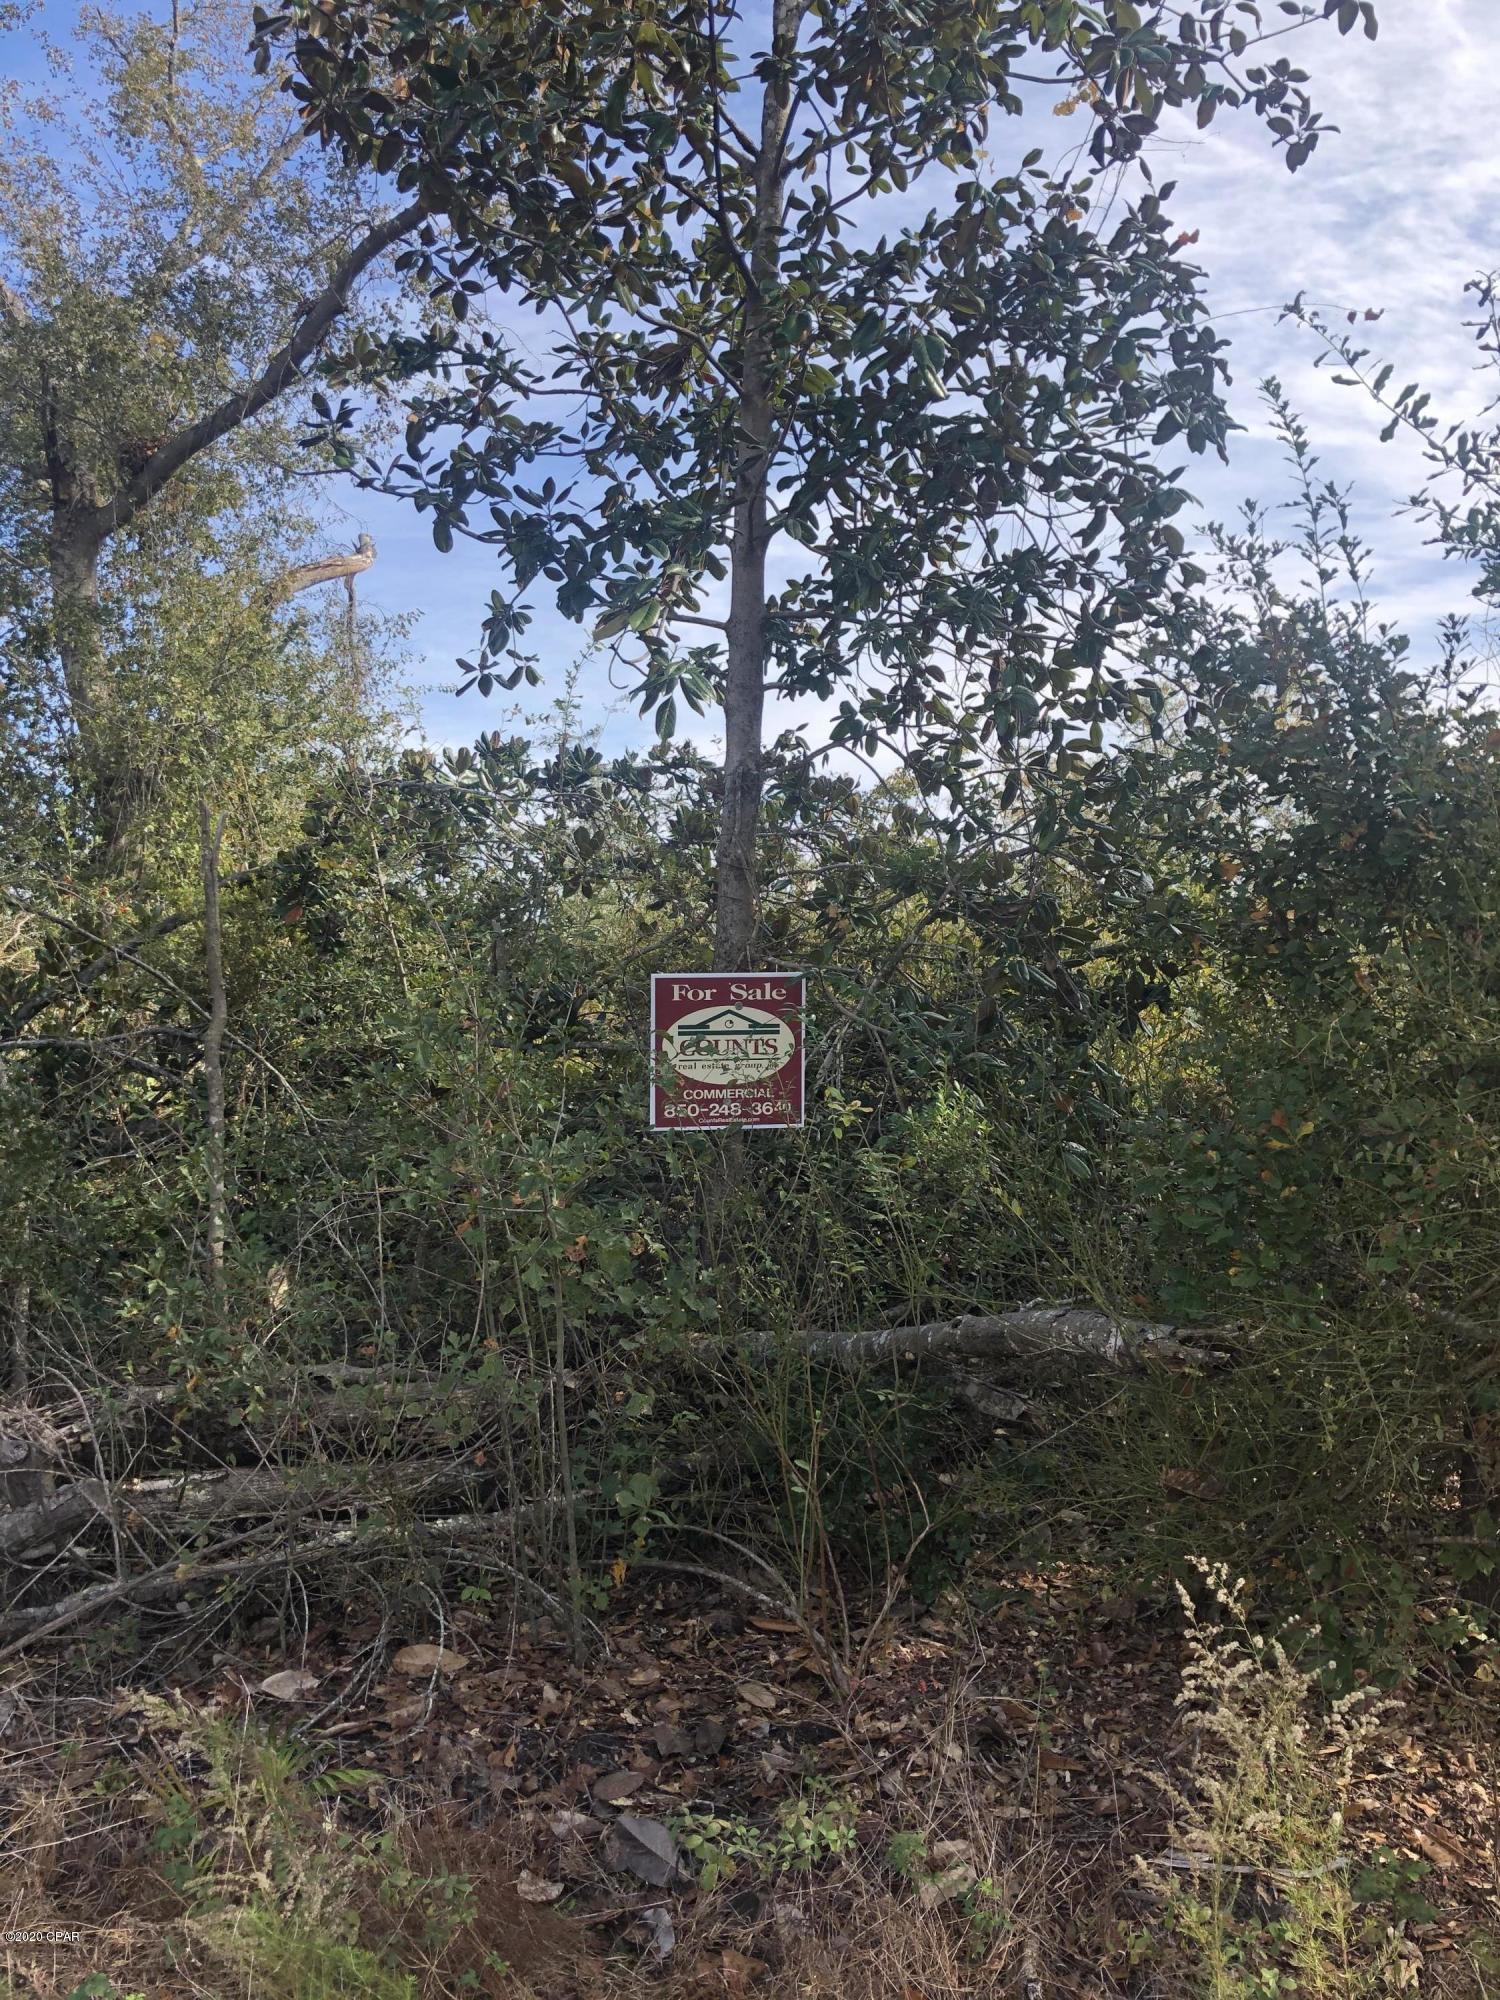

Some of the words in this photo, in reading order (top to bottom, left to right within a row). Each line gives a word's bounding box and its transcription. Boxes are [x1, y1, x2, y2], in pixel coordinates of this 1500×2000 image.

[671, 984, 717, 1001] For
[730, 982, 787, 1001] Sale
[679, 1037, 779, 1057] COUNTS
[678, 1062, 697, 1070] real
[683, 1087, 775, 1100] COMMERCIAL
